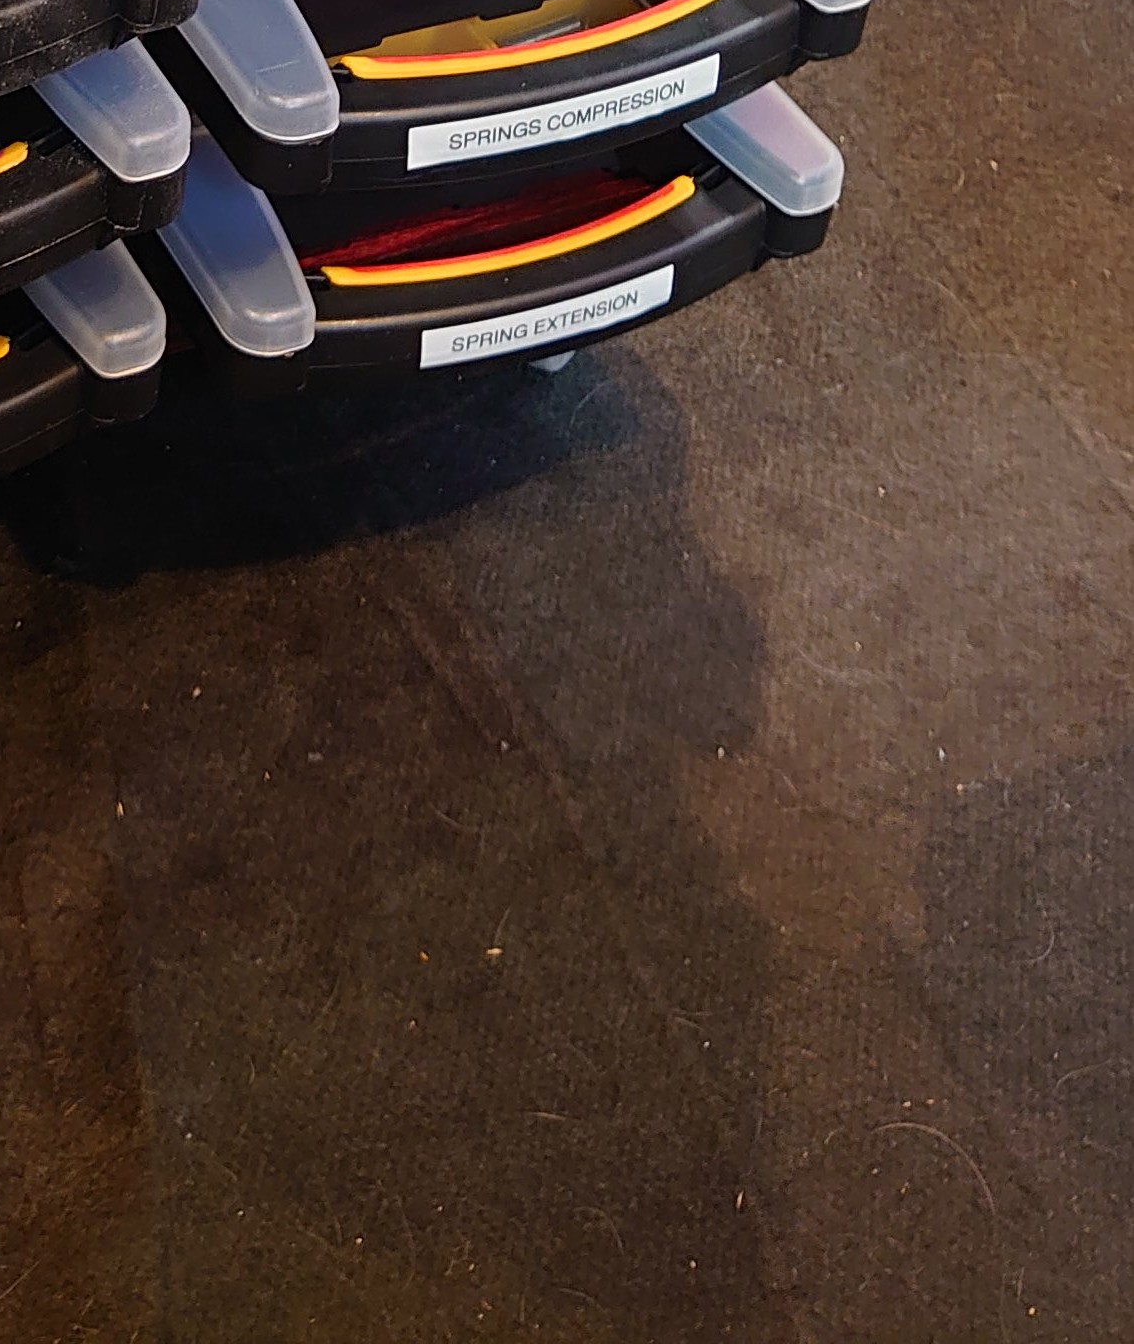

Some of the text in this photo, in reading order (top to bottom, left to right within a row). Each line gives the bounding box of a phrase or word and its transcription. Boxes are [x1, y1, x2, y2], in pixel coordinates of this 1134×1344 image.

[448, 79, 685, 151] SPRINGS COMPRESSION
[451, 290, 638, 353] SPRING EXTENSION
